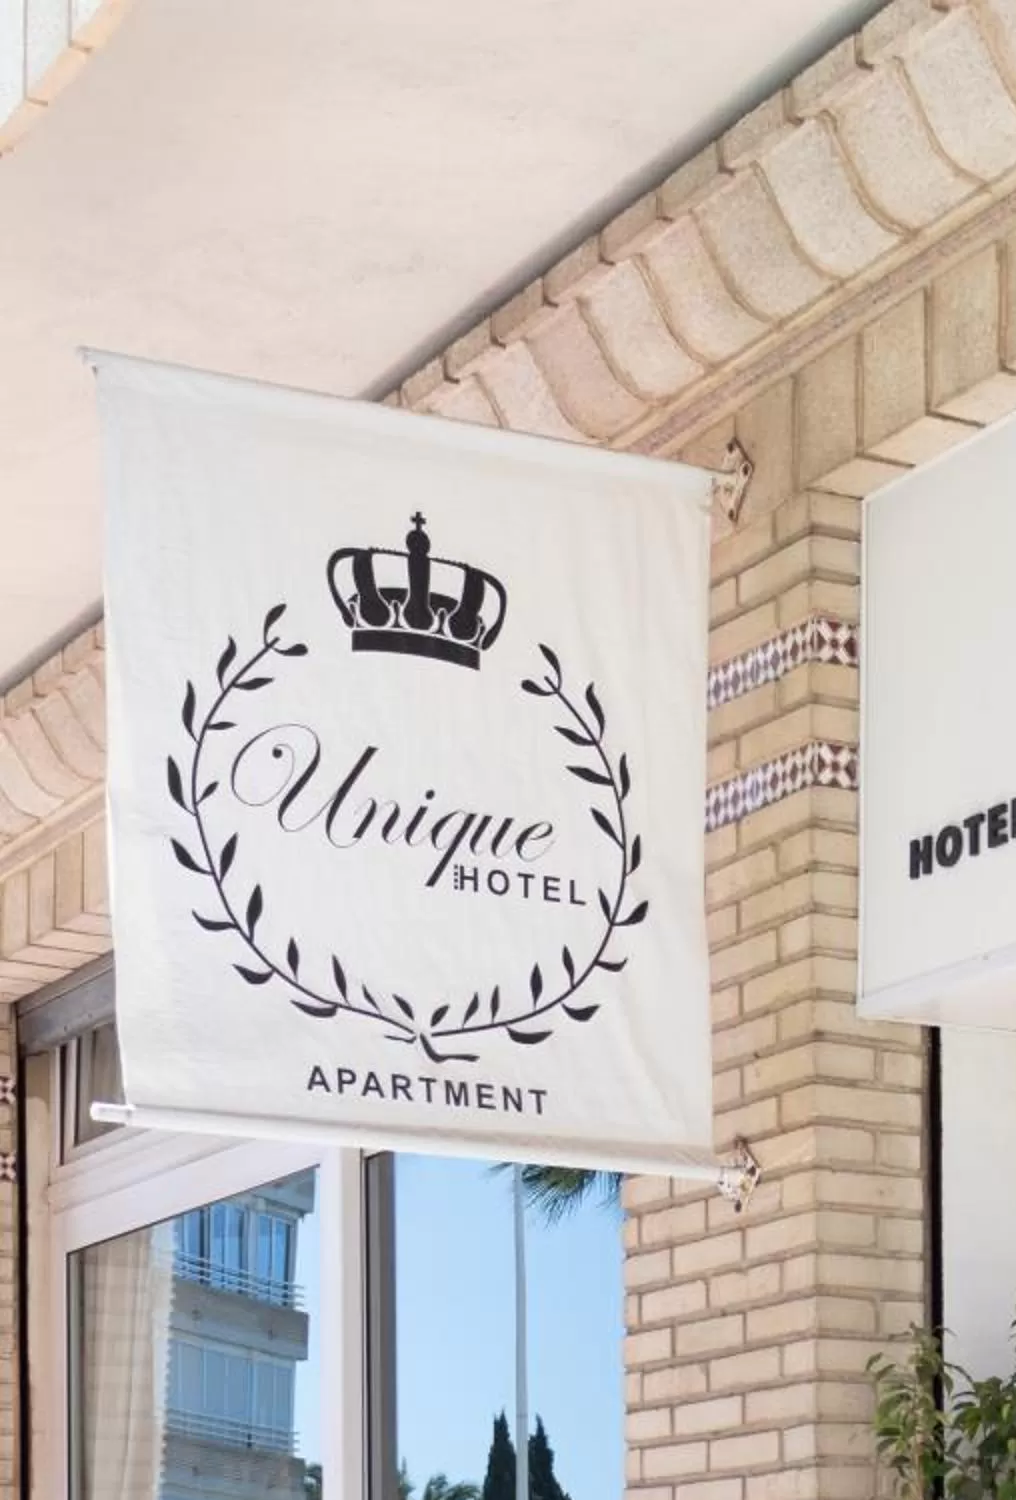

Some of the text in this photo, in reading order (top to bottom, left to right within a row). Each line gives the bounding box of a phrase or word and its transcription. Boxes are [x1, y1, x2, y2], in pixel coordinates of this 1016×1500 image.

[230, 723, 556, 888] Unique
[459, 865, 587, 906] HOTEL
[306, 1064, 548, 1116] APARTMENT
